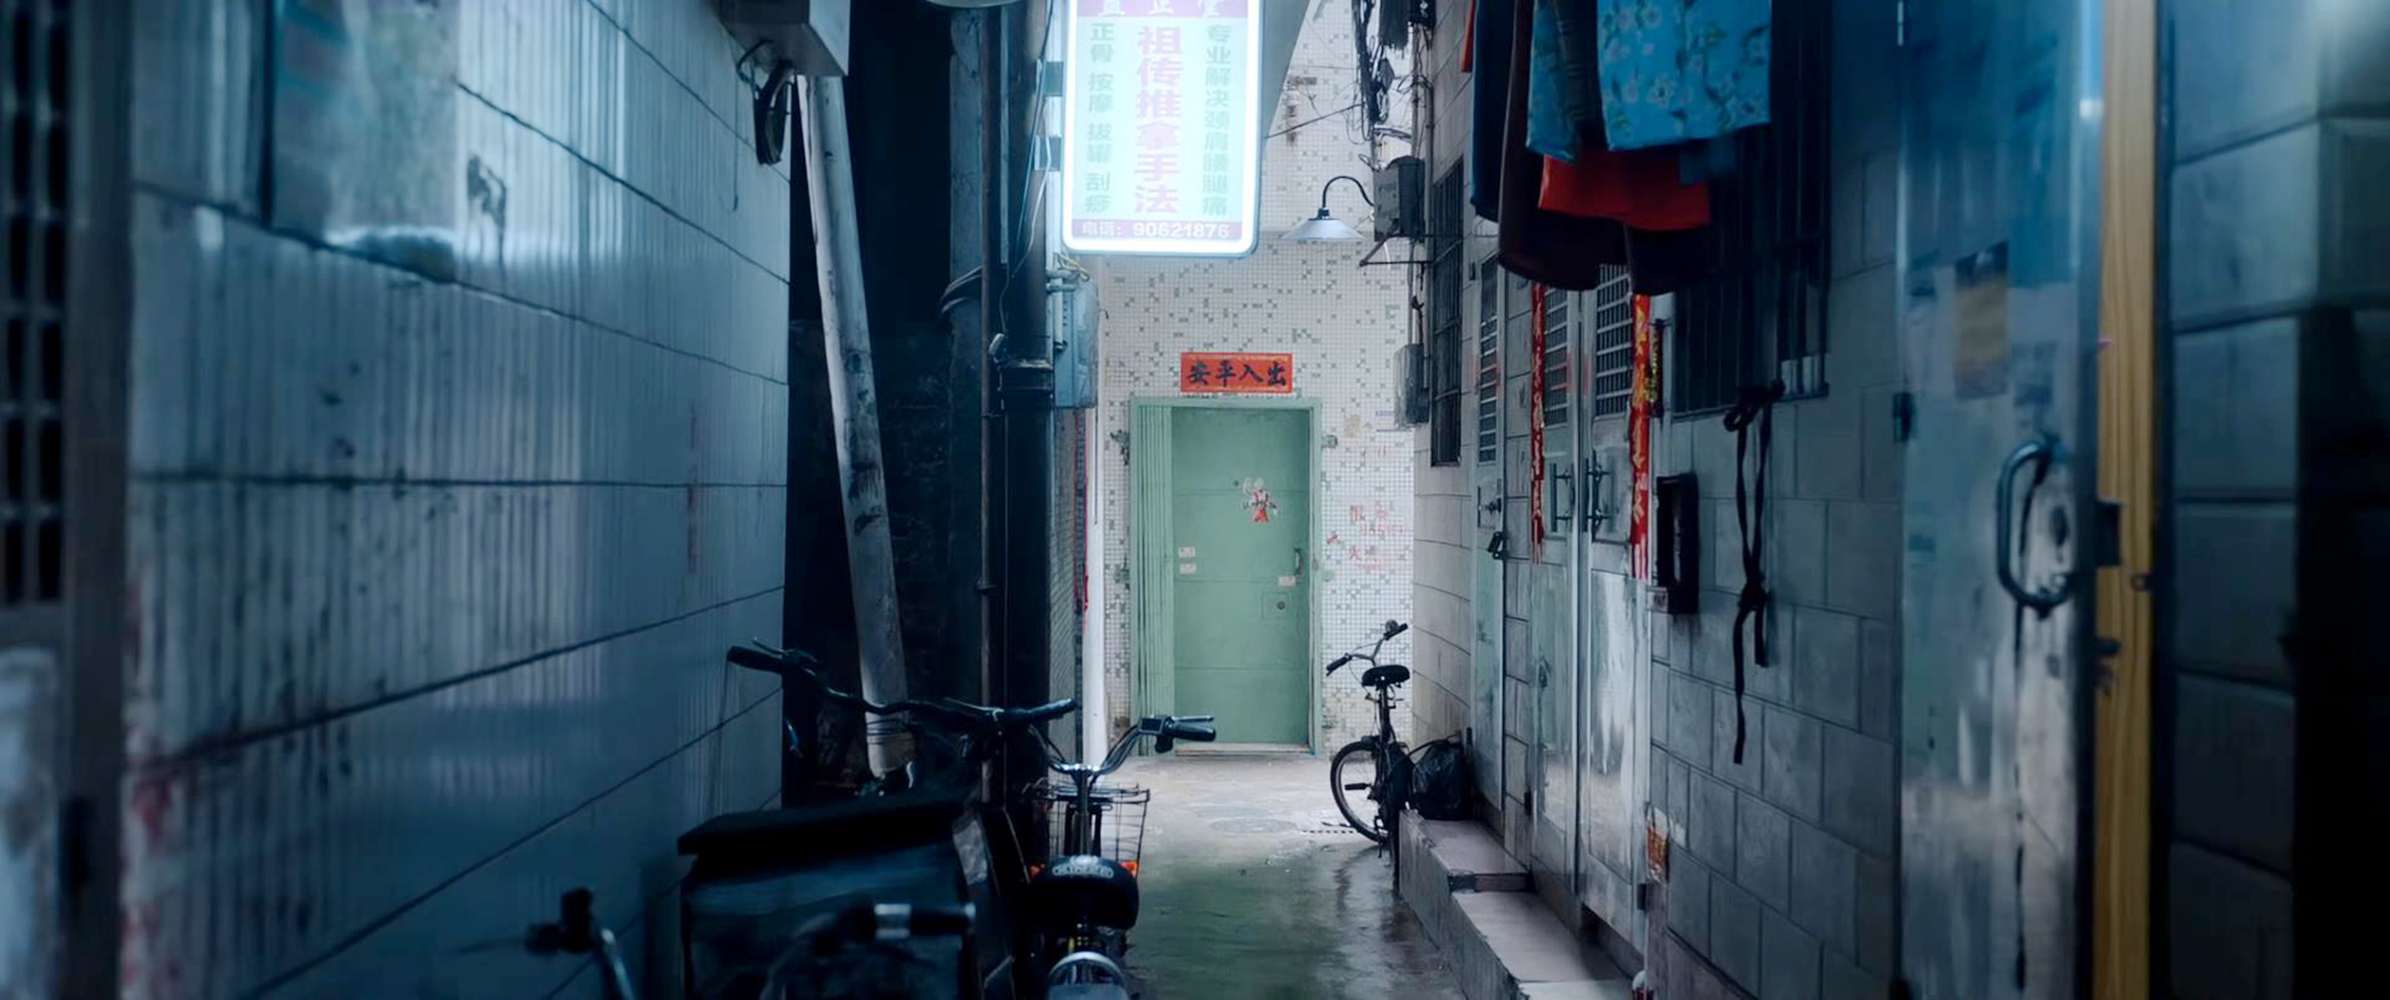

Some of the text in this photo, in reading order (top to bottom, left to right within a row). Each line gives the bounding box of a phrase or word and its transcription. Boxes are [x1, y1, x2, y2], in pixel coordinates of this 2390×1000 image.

[1087, 72, 1115, 113] 按摩
[1134, 25, 1183, 214] 祖传推拿手法
[1202, 24, 1232, 216] 专业解决颈肩腰腿痛
[1086, 122, 1113, 163] 拔罐
[1085, 172, 1112, 214] 刮痧
[1133, 222, 1229, 238] 90621876
